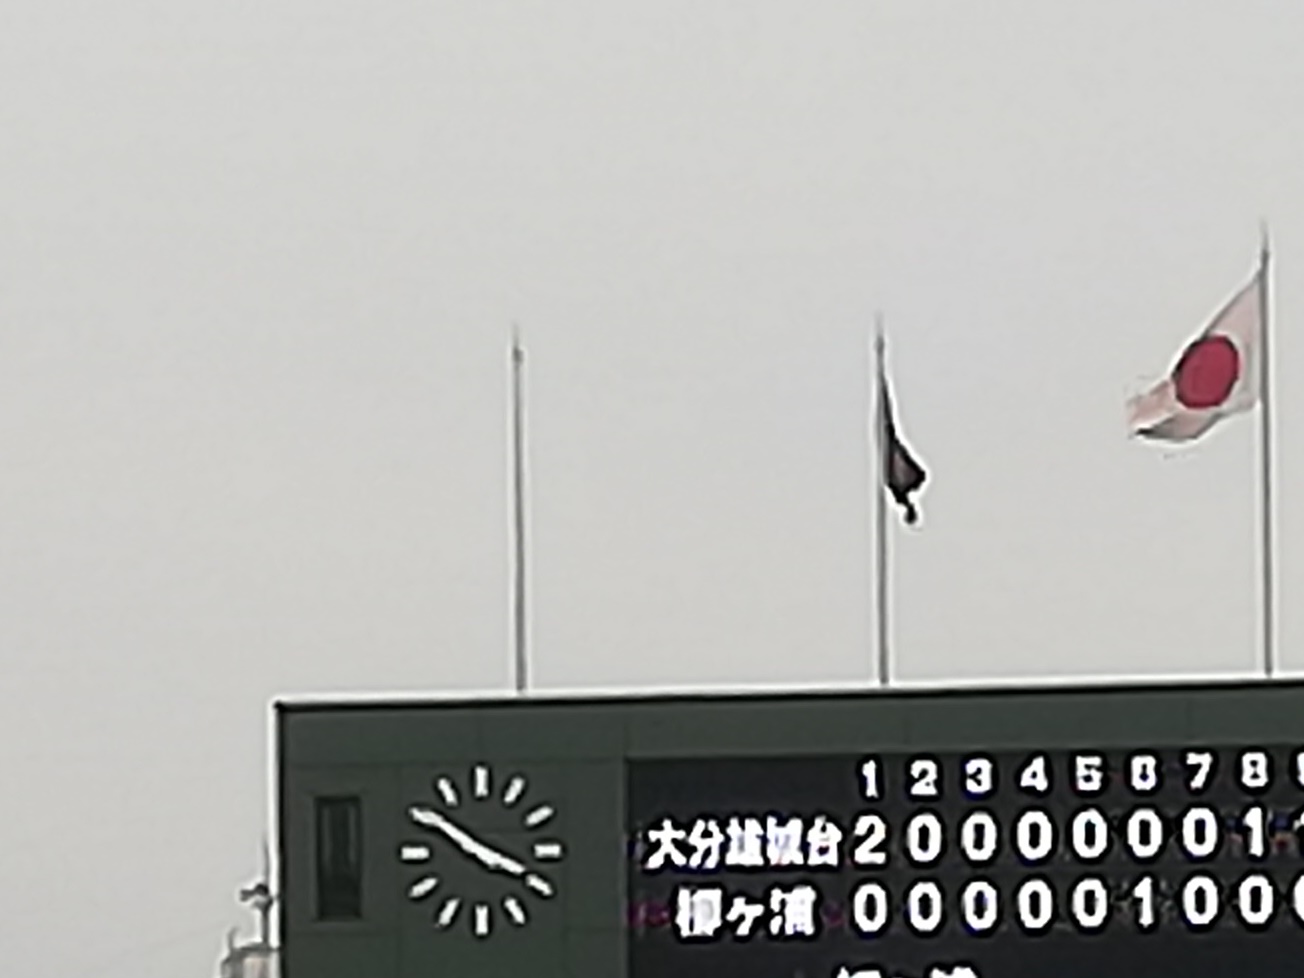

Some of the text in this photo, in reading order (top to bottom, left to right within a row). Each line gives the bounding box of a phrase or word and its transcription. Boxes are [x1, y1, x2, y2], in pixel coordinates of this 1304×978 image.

[863, 760, 877, 796] 1
[911, 760, 937, 795] 2
[966, 759, 991, 792] 3
[1021, 757, 1047, 791] 4
[1076, 756, 1102, 790] 5
[1187, 753, 1212, 788] 7
[1242, 753, 1267, 787] 8
[854, 816, 885, 864] 2
[908, 814, 941, 861] 0
[962, 813, 996, 860] 0
[1018, 812, 1052, 859] 0
[1073, 809, 1107, 858] 0
[1128, 810, 1162, 857] 0
[1183, 808, 1217, 856] 0
[1244, 808, 1263, 856] 1
[854, 884, 886, 931] 0
[909, 882, 941, 930] 0
[963, 882, 996, 929] 0
[1018, 880, 1052, 928] 0
[1073, 880, 1107, 926] 0
[1134, 877, 1153, 926] 1
[1183, 877, 1218, 924] 0
[1239, 876, 1273, 923] 0
